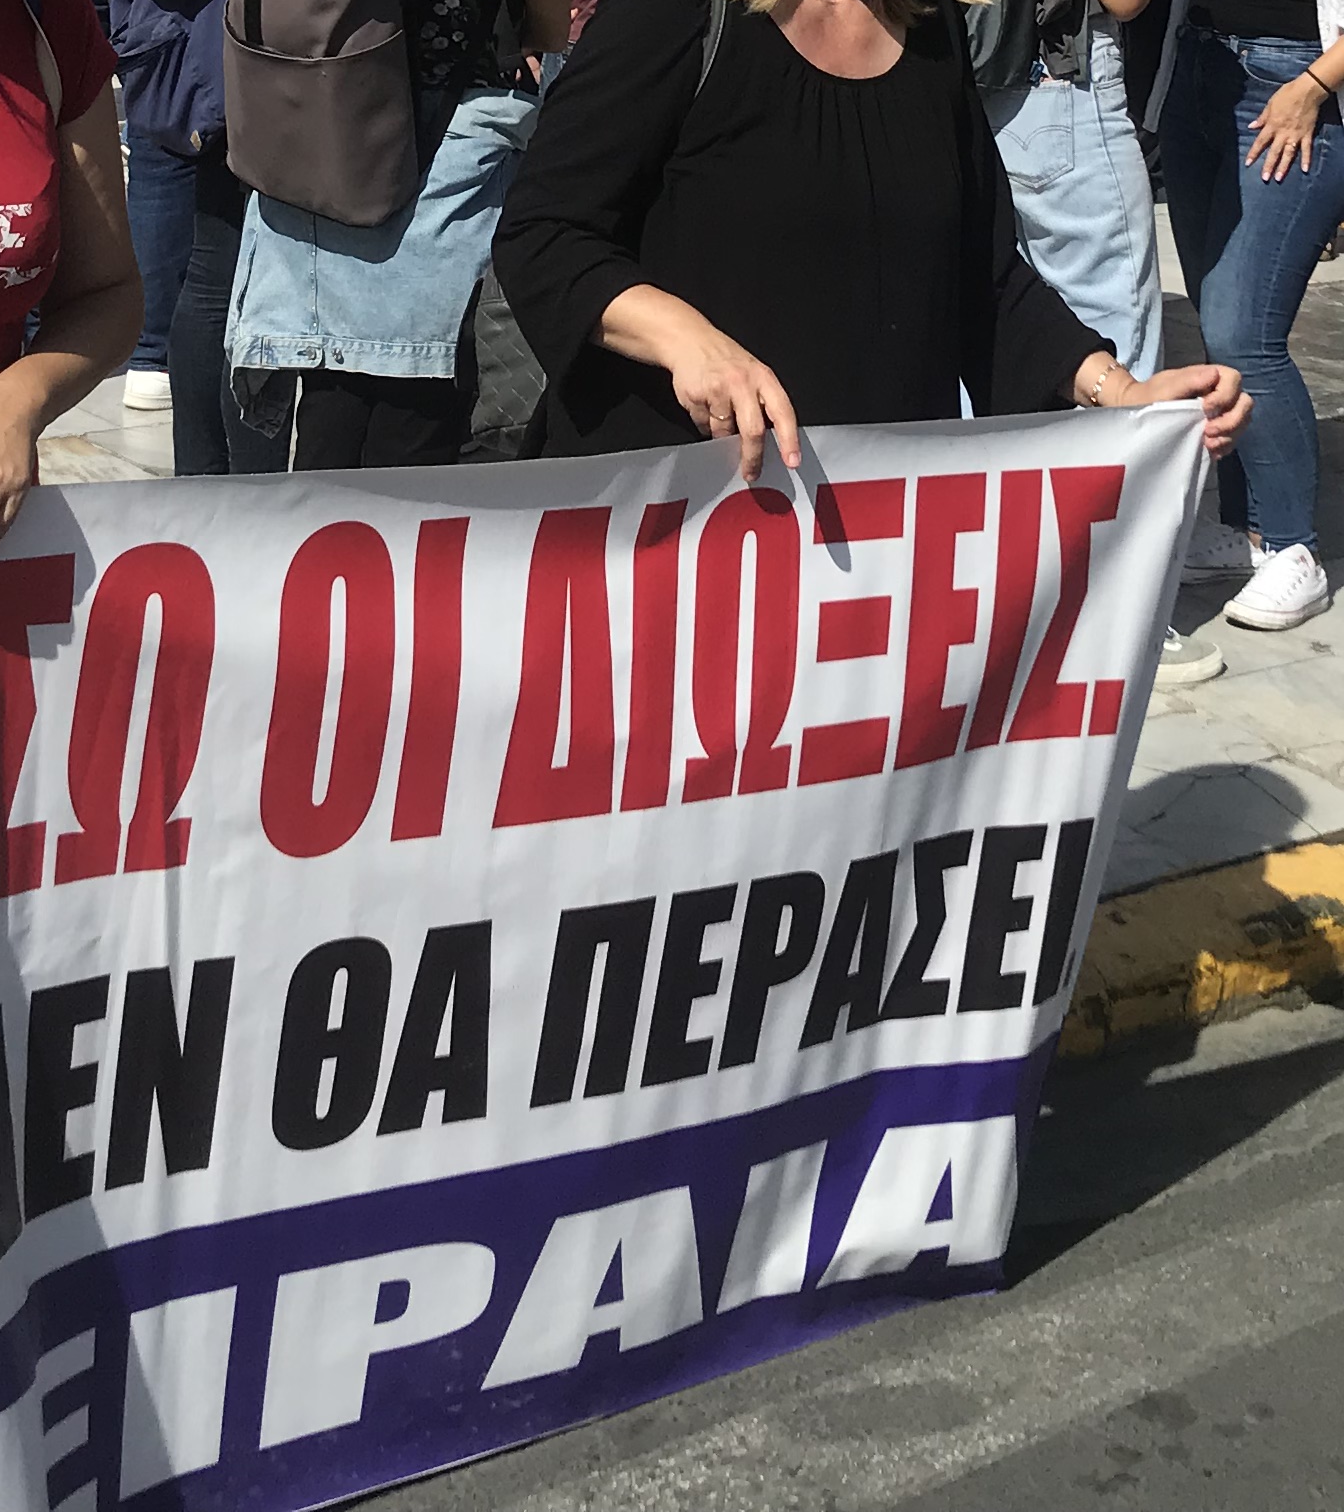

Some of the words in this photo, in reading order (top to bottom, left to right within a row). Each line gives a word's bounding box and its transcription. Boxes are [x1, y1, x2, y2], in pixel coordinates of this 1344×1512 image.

[258, 516, 471, 859] ΟΙ
[270, 920, 492, 1154] ΘΑ
[531, 817, 1095, 1106] ΠΕΡΑΣΕΙ
